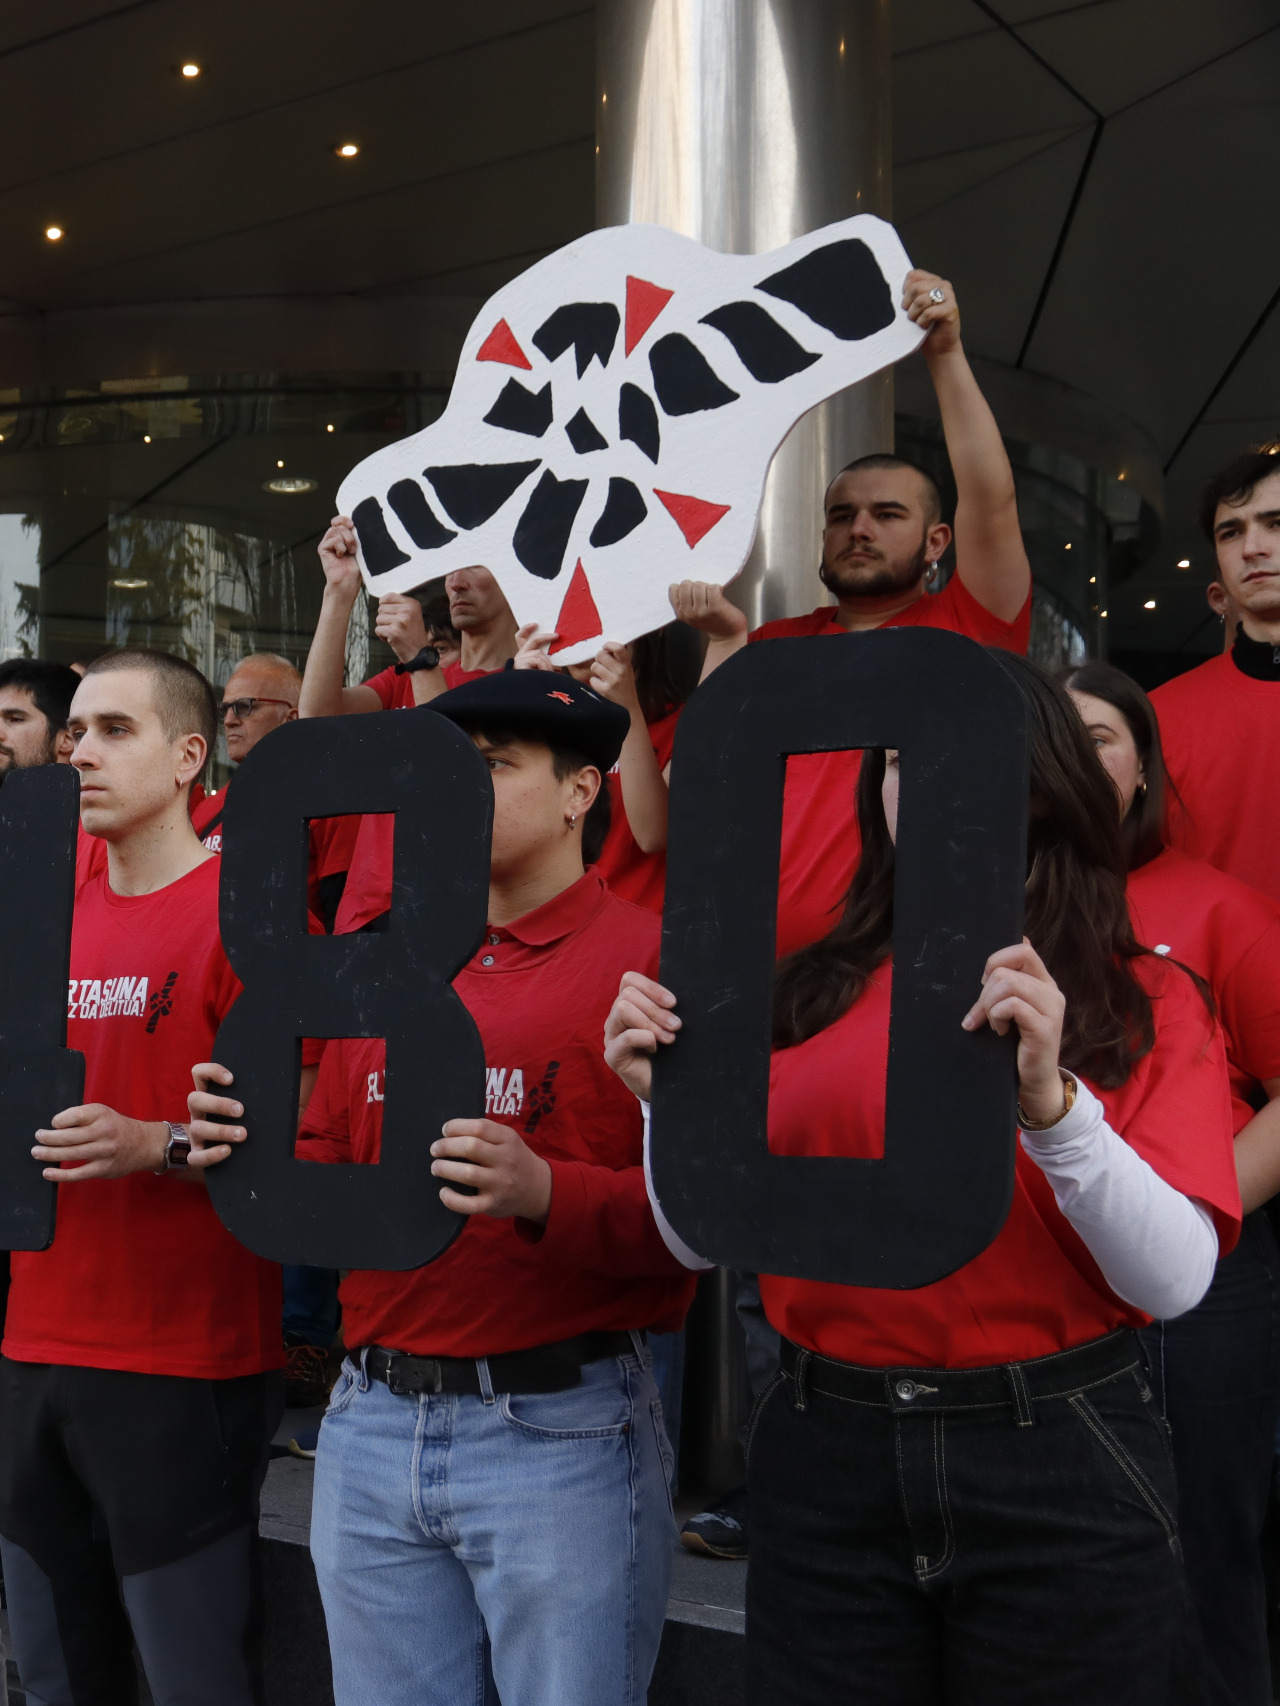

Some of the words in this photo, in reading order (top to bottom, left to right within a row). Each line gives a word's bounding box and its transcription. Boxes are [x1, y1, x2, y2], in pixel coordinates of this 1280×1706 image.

[68, 976, 149, 1006] RTASUNA
[67, 1002, 79, 1018] Z
[79, 1002, 98, 1019] DA
[99, 999, 146, 1018] DELITUA!
[485, 1095, 523, 1115] TUA!
